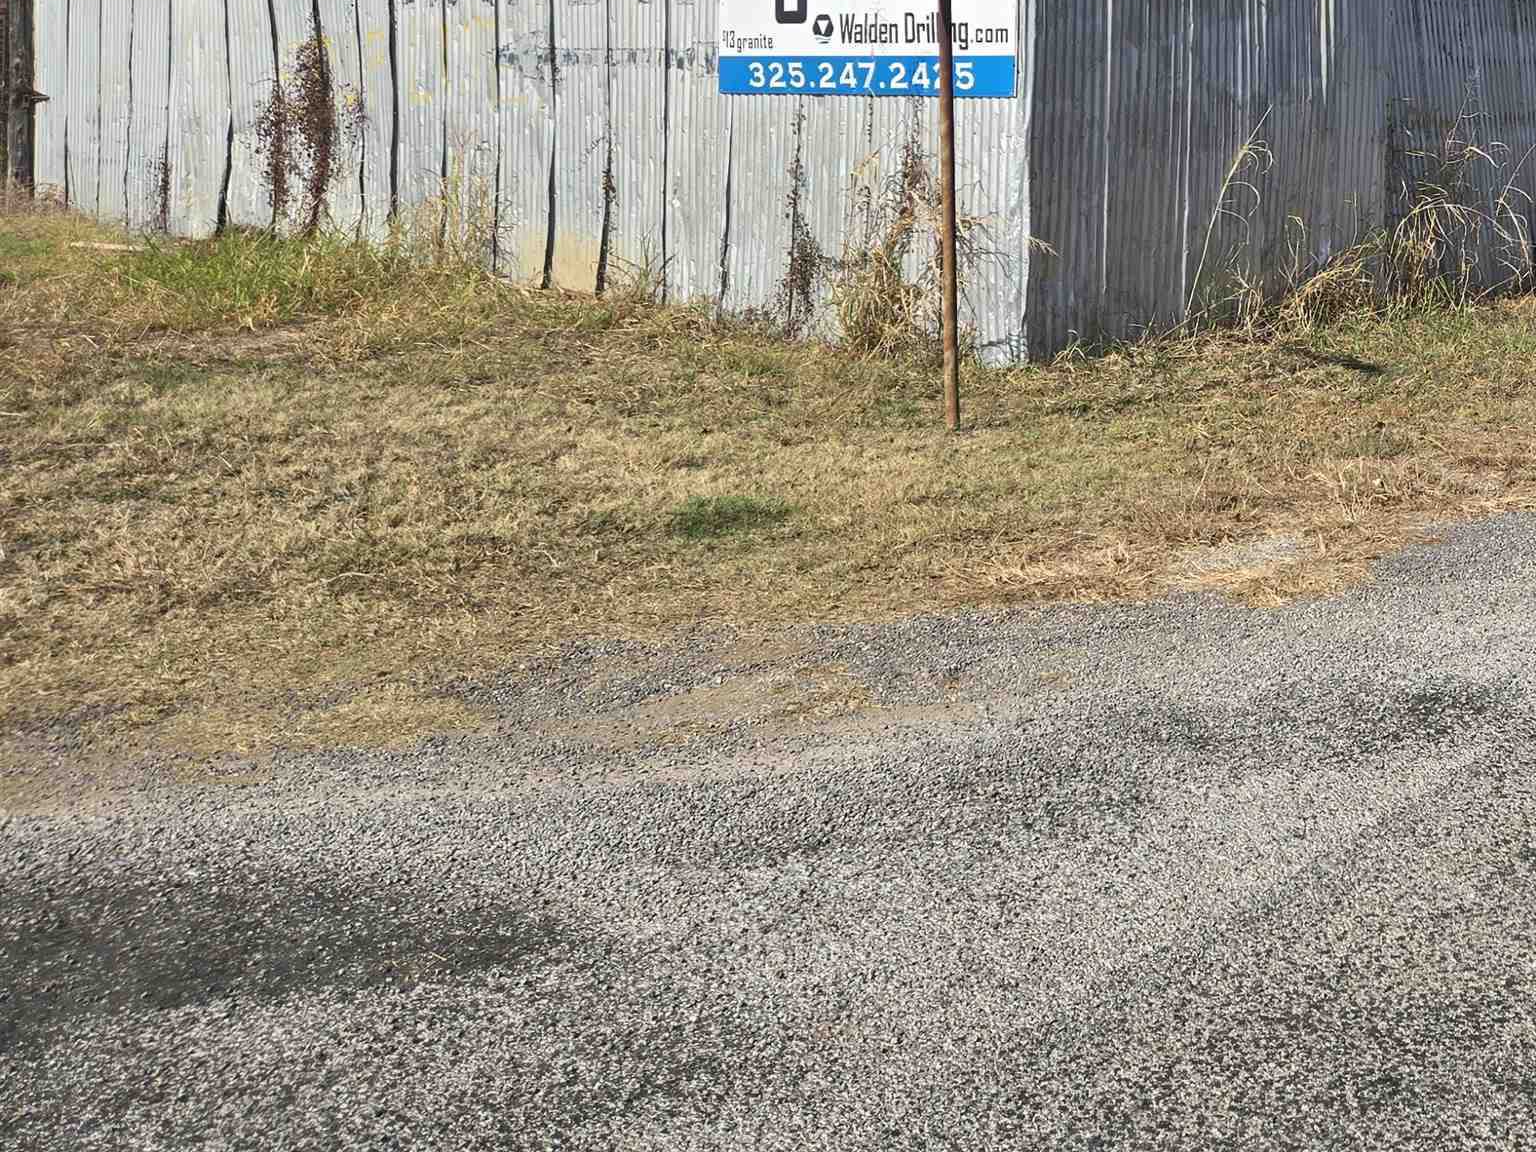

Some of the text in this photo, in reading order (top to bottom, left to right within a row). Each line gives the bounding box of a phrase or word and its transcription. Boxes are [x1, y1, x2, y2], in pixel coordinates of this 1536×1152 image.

[737, 33, 773, 53] granite
[839, 11, 1009, 50] Walden Drillng.com
